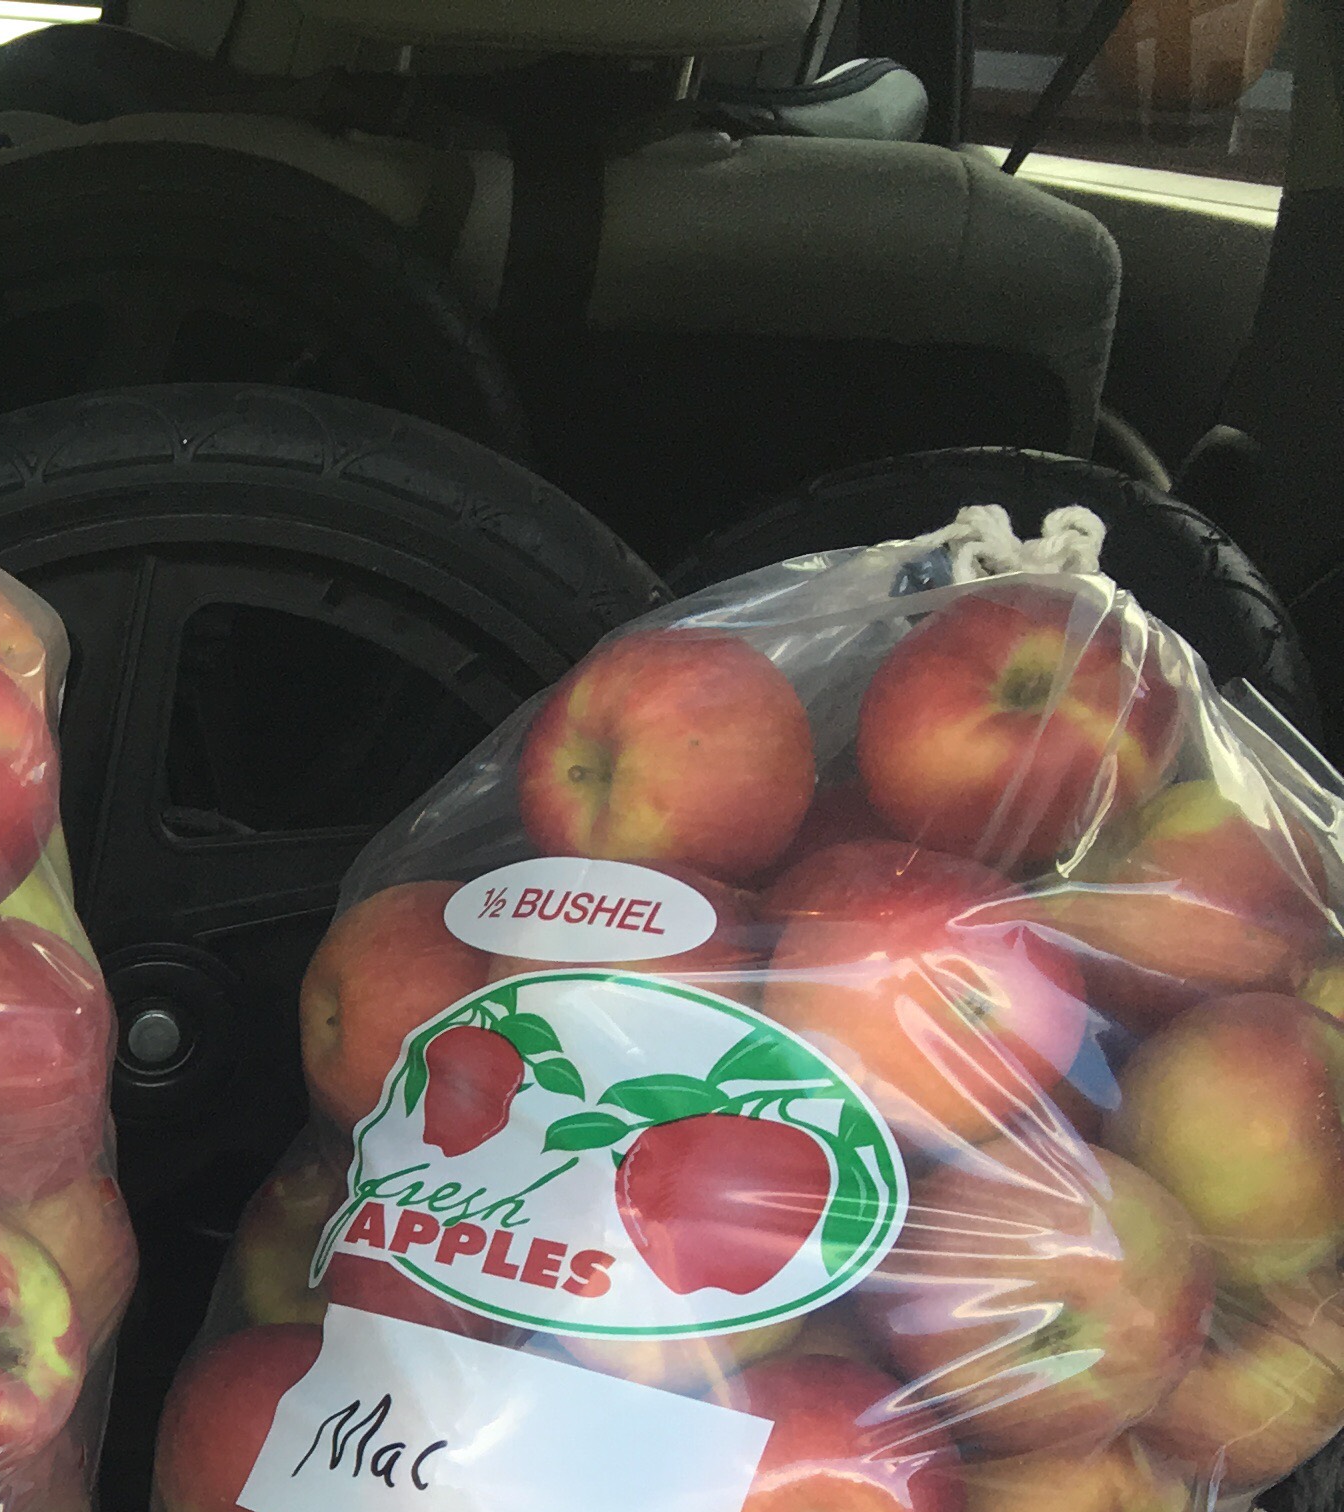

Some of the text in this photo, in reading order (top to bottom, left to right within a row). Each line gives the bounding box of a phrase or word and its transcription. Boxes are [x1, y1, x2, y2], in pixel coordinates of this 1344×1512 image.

[512, 888, 665, 935] BUSHEL
[314, 1157, 579, 1279] fresh
[343, 1201, 616, 1298] APPLES
[291, 1393, 448, 1490] Mac
